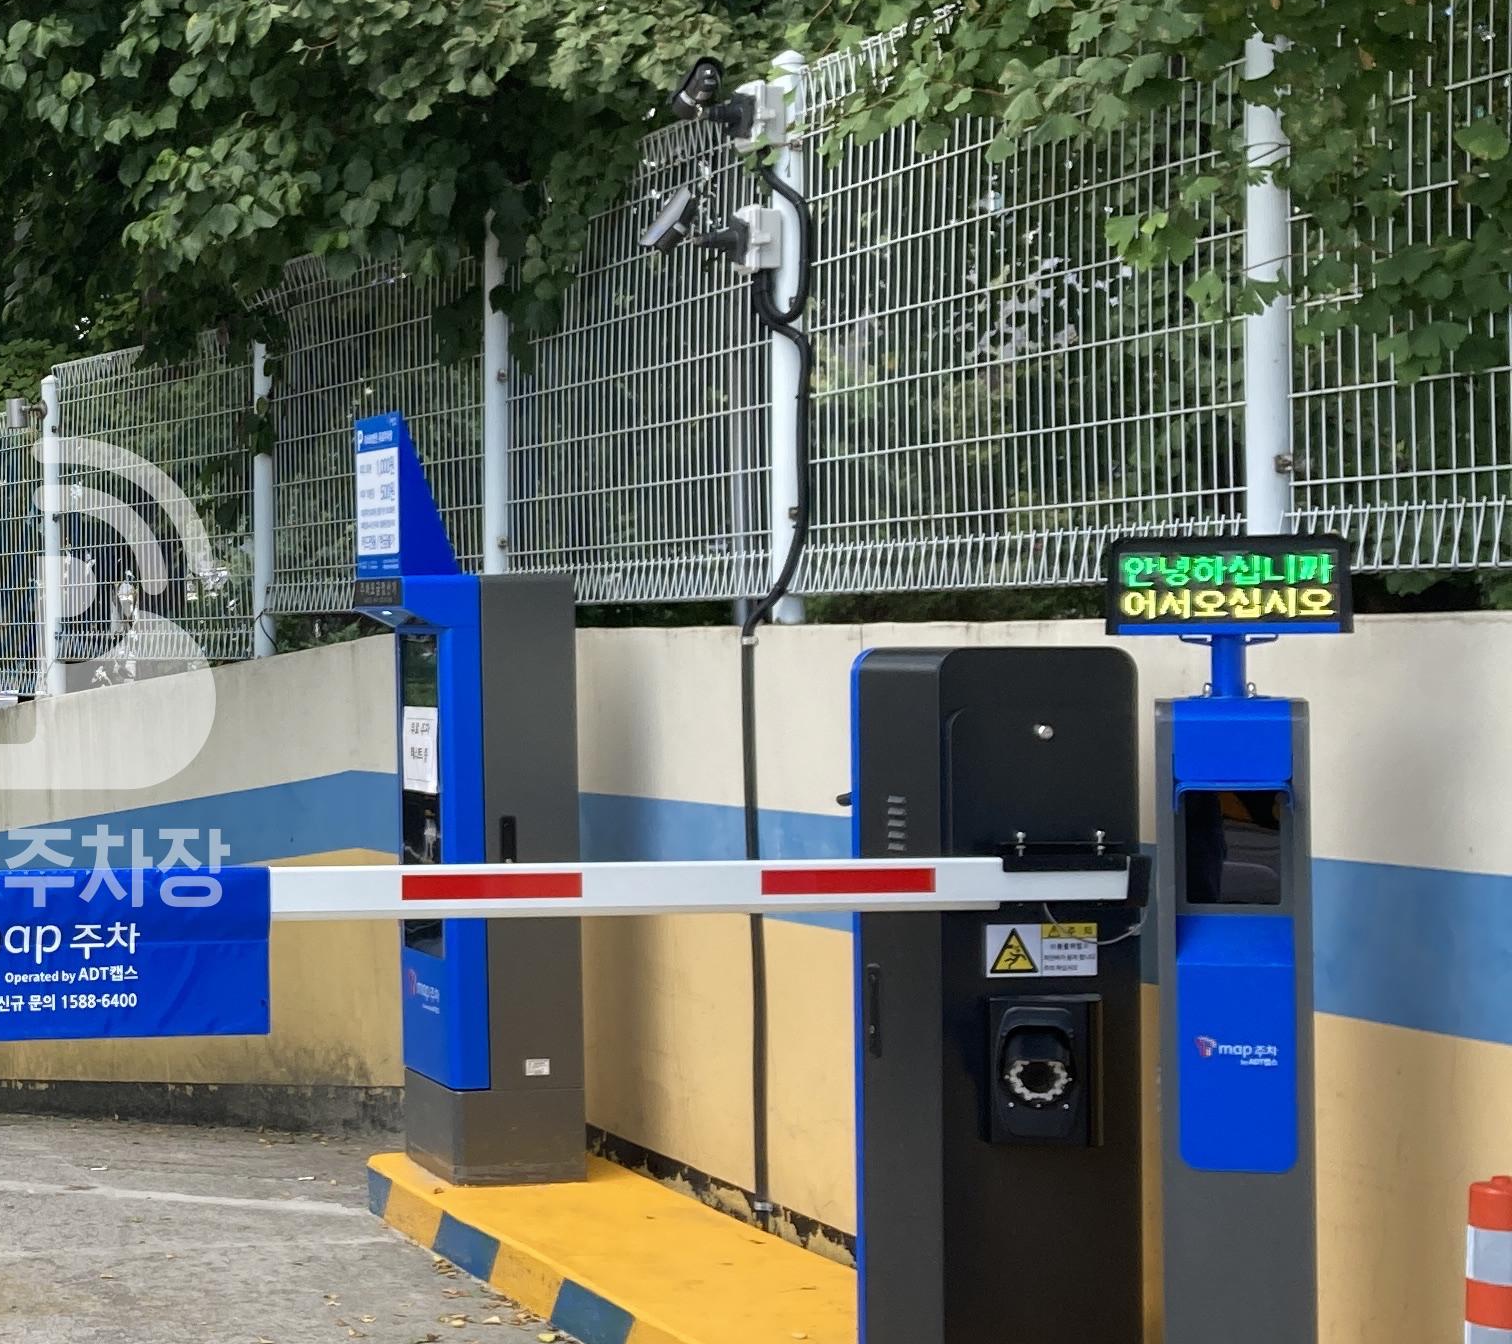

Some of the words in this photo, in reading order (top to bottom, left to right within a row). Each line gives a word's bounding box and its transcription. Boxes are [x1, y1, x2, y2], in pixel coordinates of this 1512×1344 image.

[1124, 553, 1334, 587] 안녕하십니까
[1123, 587, 1336, 619] 어서오십시오
[69, 922, 140, 960] 주차
[4, 971, 59, 985] Operated
[61, 970, 76, 984] by
[78, 965, 138, 982] ADT캡스
[28, 994, 56, 1011] 문의
[61, 993, 138, 1009] 1588-6400
